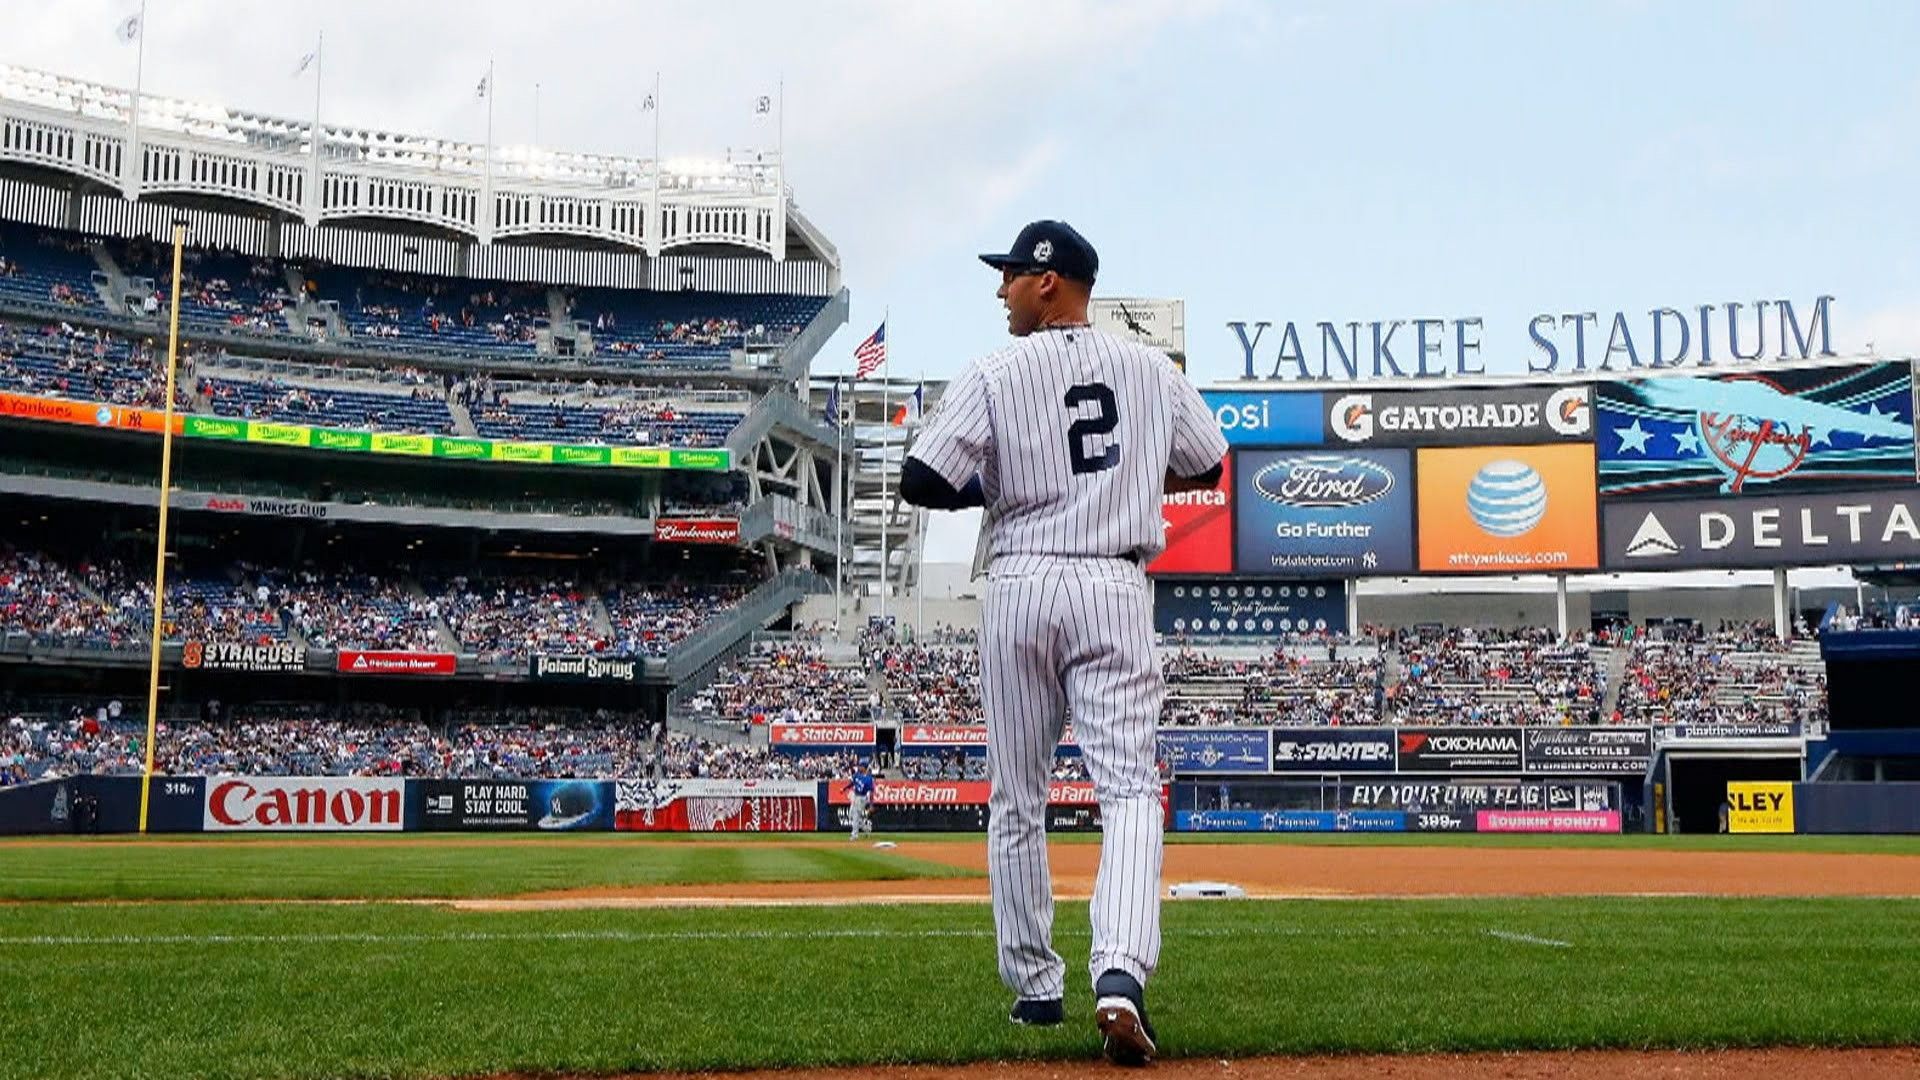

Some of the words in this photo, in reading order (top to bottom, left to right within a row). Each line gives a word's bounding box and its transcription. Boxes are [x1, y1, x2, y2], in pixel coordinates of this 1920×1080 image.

[1226, 316, 1486, 381] YANKEE
[1527, 294, 1836, 374] STADIUM
[1215, 399, 1269, 430] psi
[1379, 403, 1540, 431] GATORADE
[1064, 381, 1121, 475] 2
[1281, 462, 1364, 499] Ford
[1162, 488, 1225, 506] merica
[300, 505, 327, 517] CLUB
[1277, 523, 1303, 538] Go
[1305, 522, 1371, 538] Further
[1700, 504, 1920, 550] DELTA
[204, 641, 305, 664] SYRACUSE
[537, 658, 585, 678] Poland
[1303, 742, 1390, 760] STARTER
[1427, 737, 1517, 751] YOKOHAMA
[1544, 746, 1630, 755] COLLECTIBLES
[464, 785, 493, 799] PLAY
[495, 785, 529, 799] HARD.
[1352, 785, 1386, 804] FLY
[209, 780, 399, 825] Canon
[465, 800, 492, 813] STAY
[495, 800, 527, 813] COOL.
[1553, 816, 1607, 827] DONUTS
